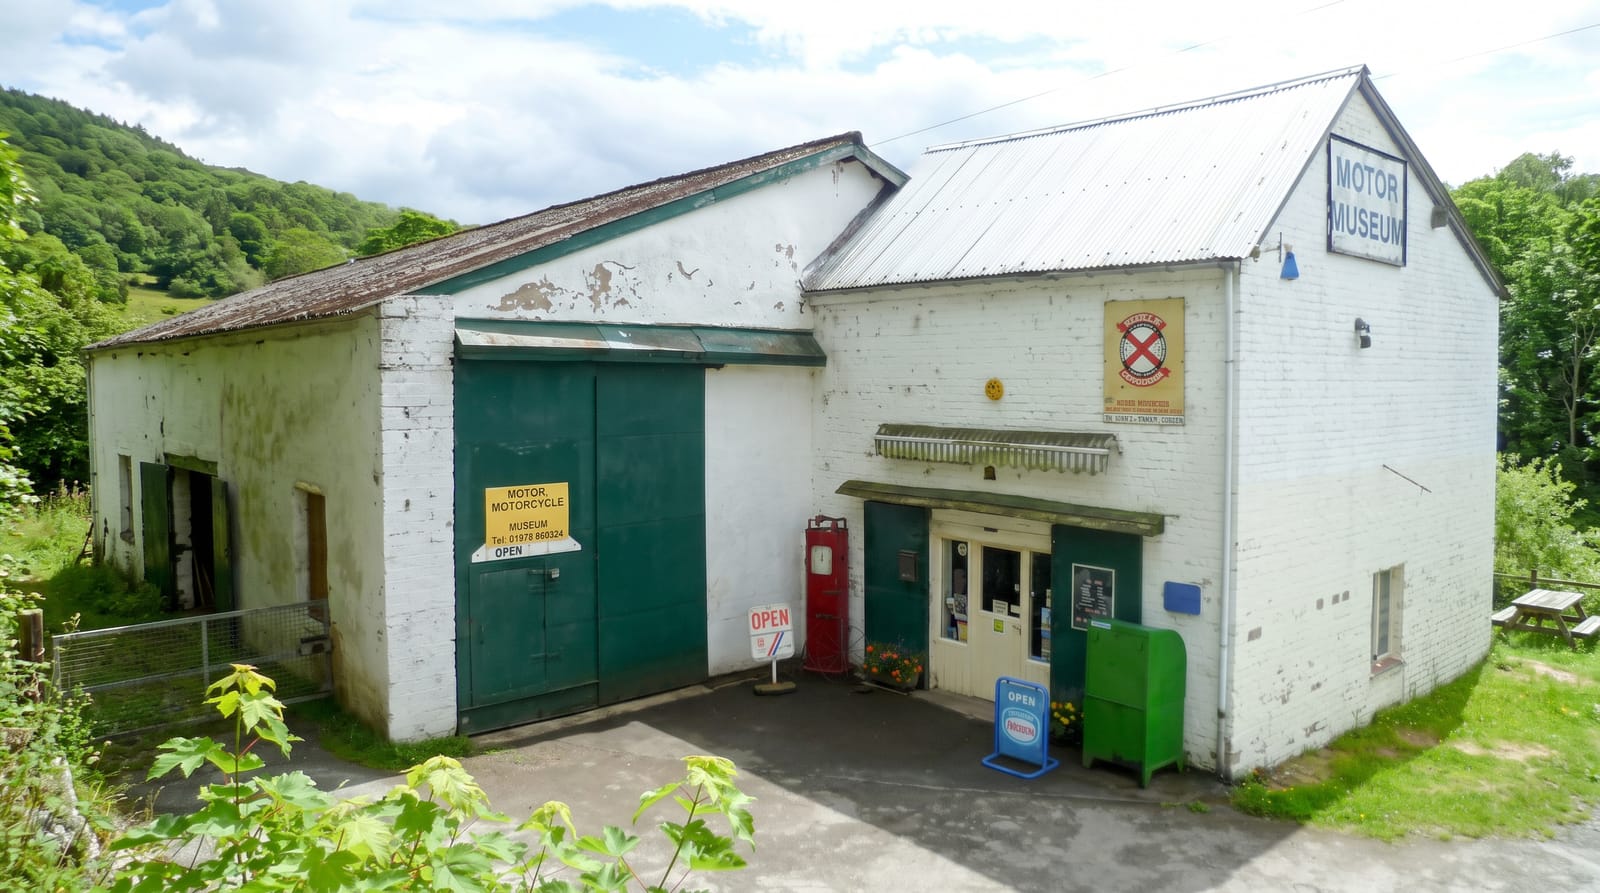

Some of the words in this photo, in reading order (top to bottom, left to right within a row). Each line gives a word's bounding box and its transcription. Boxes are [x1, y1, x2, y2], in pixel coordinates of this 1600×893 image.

[1336, 156, 1398, 203] MOTOR
[1331, 200, 1404, 246] MUSEUM
[508, 488, 548, 498] MOTOR,
[491, 497, 564, 512] MOTORCYCLE
[509, 520, 548, 531] MUSEUM
[491, 536, 507, 545] Tel:
[509, 532, 534, 543] 01978
[535, 530, 564, 540] 860324
[495, 545, 523, 558] OPEN
[751, 609, 788, 630] OPEN
[1007, 691, 1036, 707] OPEN
